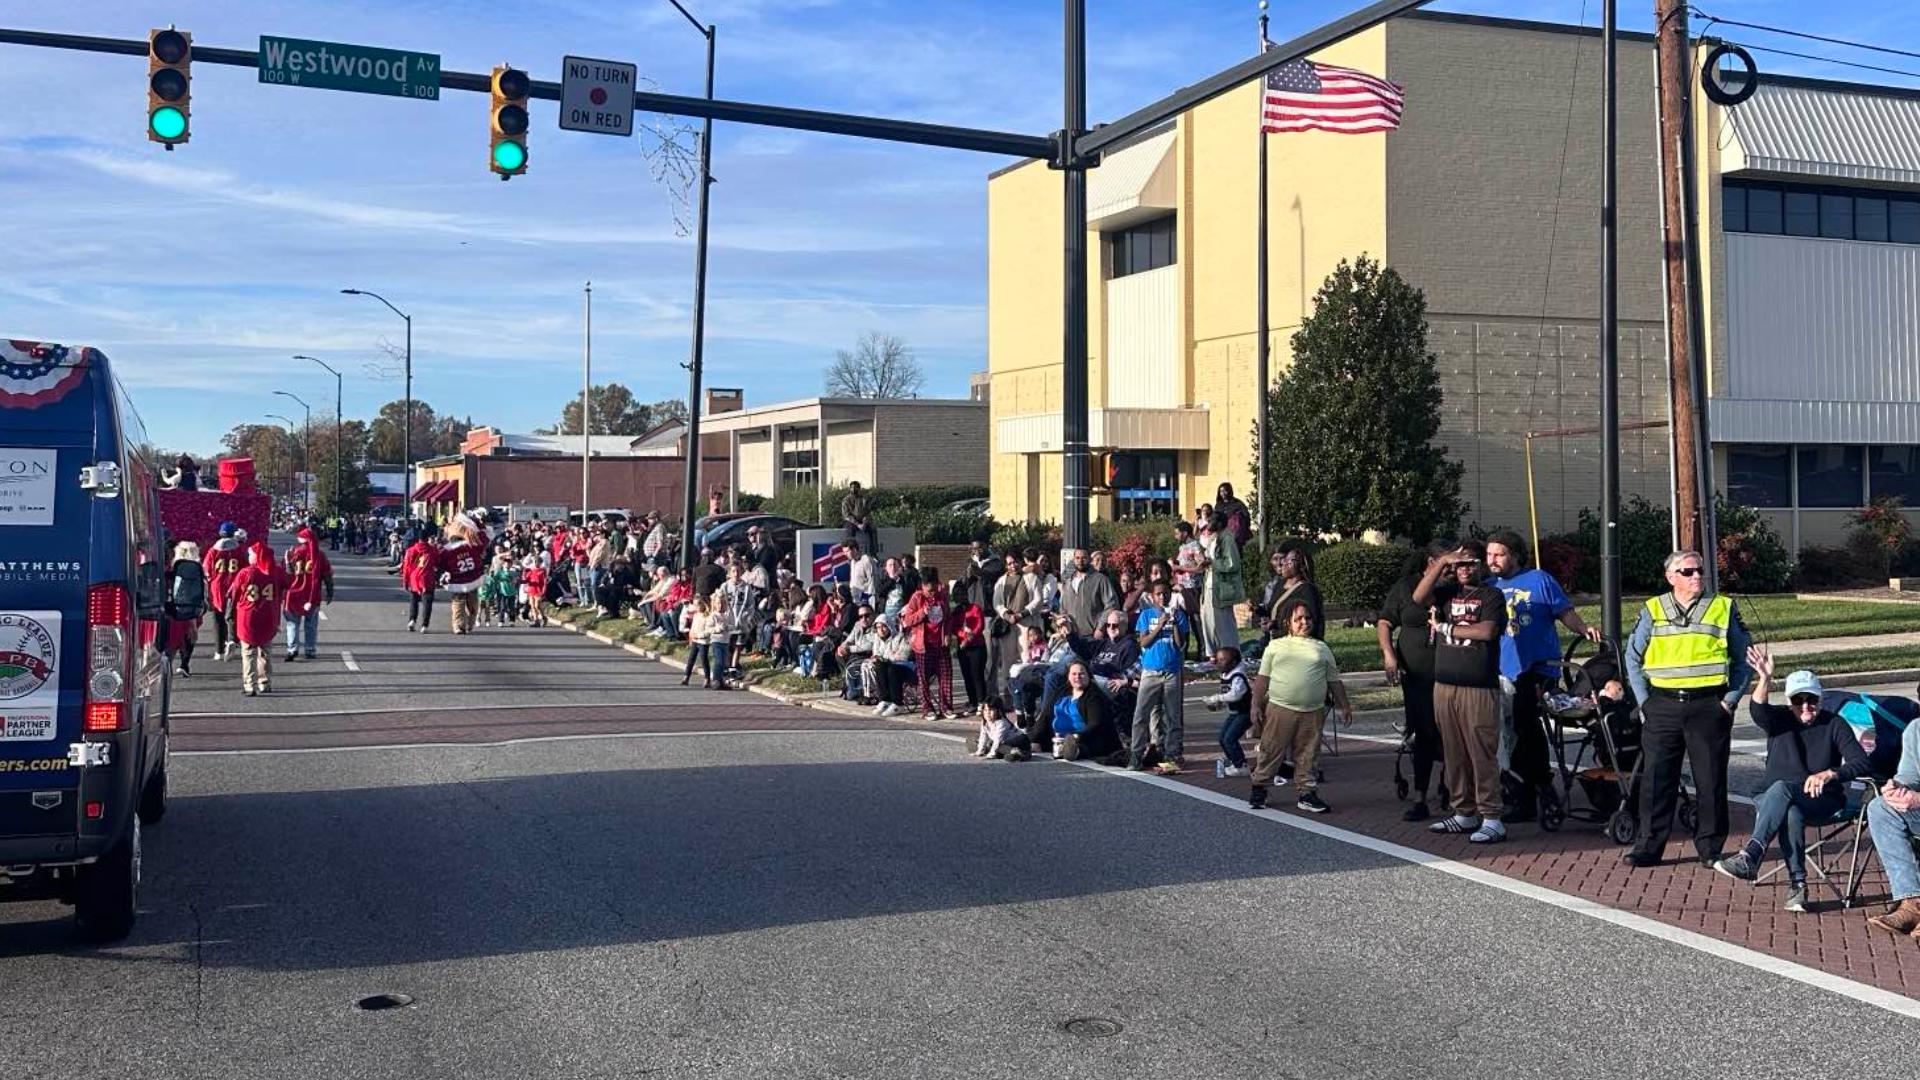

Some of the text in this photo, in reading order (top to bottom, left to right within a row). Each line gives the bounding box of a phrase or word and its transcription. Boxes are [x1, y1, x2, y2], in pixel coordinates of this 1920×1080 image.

[264, 40, 435, 83] Westwood Av
[263, 69, 300, 84] 100 W
[570, 64, 630, 84] NO TURN
[402, 83, 435, 98] E 100
[571, 109, 622, 128] ON RED
[214, 558, 240, 573] 48
[457, 558, 476, 573] 25
[40, 573, 81, 581] MEDIA
[247, 584, 274, 602] 34
[18, 618, 53, 658] LEAGUE
[7, 720, 51, 729] PARTNER
[7, 729, 46, 737] LEAGUE
[0, 758, 68, 771] ers.com
